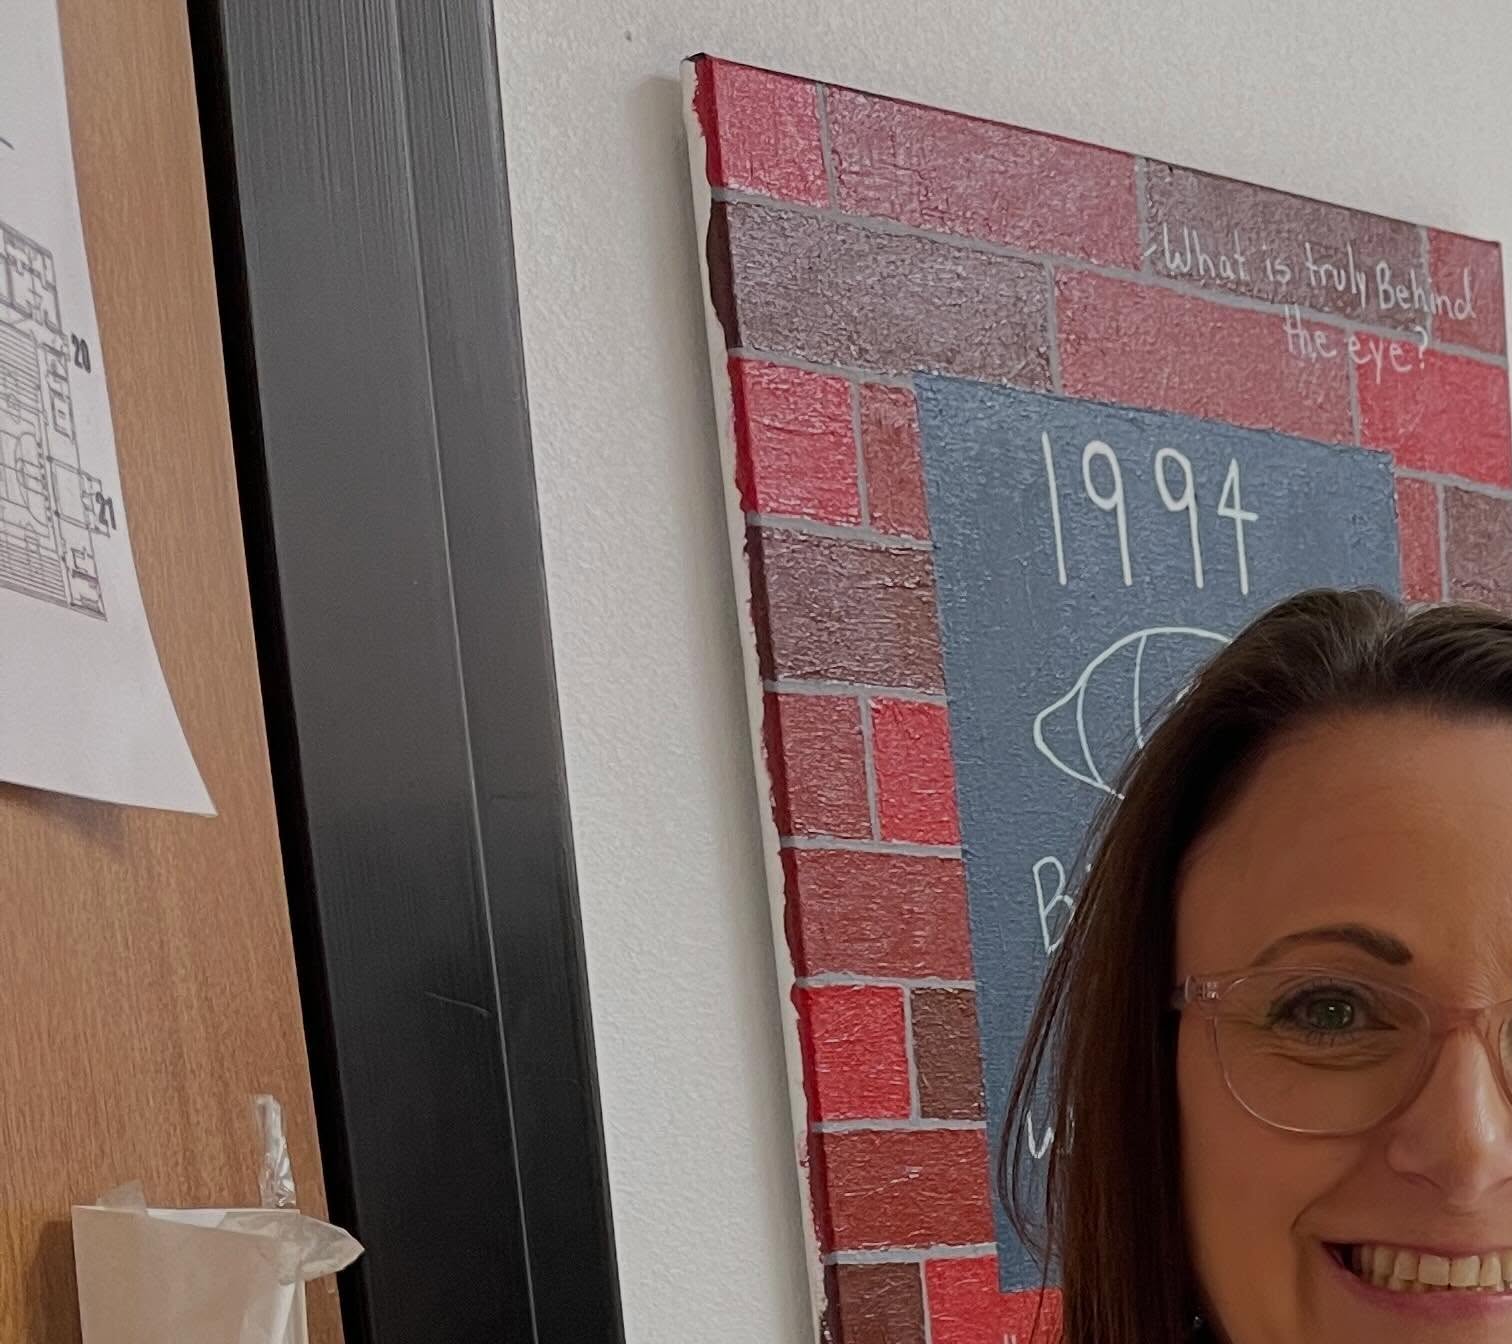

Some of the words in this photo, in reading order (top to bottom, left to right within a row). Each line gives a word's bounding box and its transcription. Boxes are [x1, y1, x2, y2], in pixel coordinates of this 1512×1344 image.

[1266, 244, 1292, 285] is
[1305, 240, 1367, 308] truly
[1375, 262, 1475, 321] Behind
[1283, 304, 1338, 364] the
[1347, 326, 1431, 385] eye?
[1041, 430, 1260, 595] 1994
